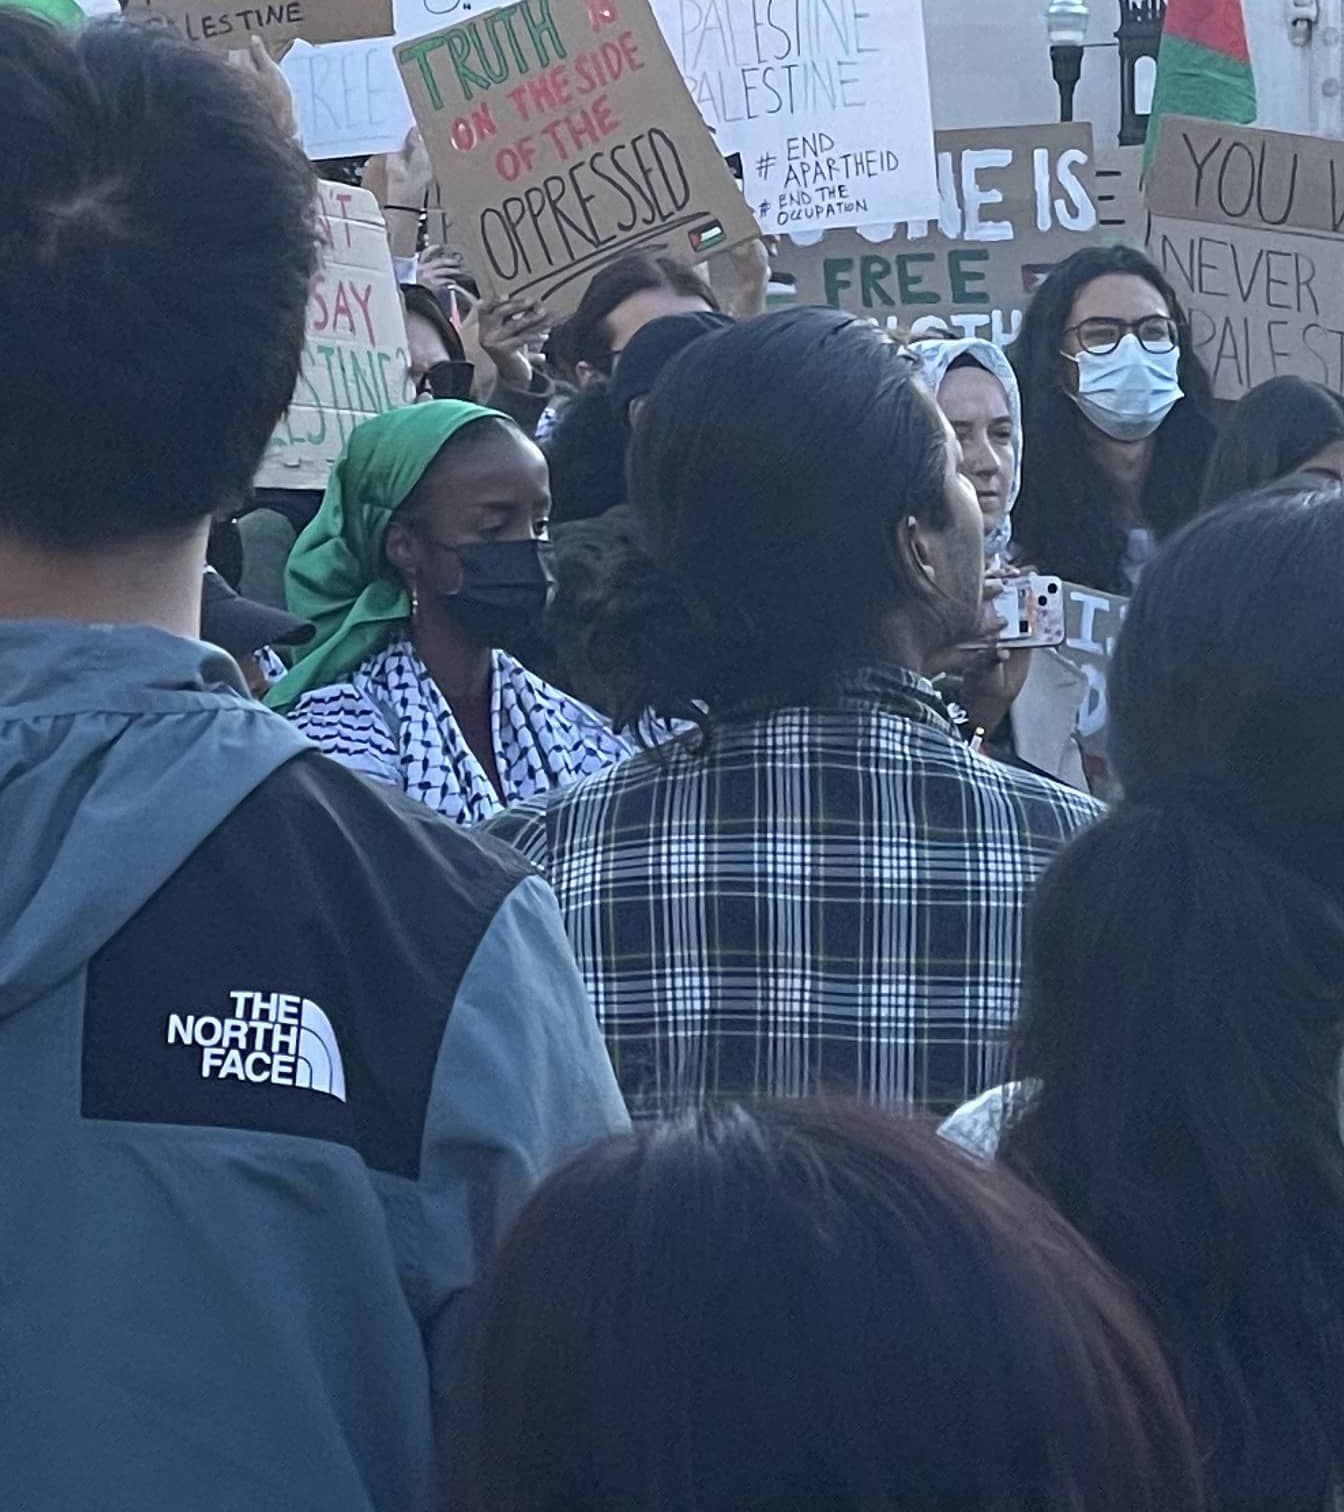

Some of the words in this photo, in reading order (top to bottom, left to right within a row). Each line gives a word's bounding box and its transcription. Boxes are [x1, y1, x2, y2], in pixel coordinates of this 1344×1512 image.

[146, 1, 304, 42] LESTINE
[450, 102, 498, 152] ON
[507, 63, 572, 122] THE
[575, 30, 645, 95] SIDE
[495, 135, 537, 183] OF
[540, 93, 623, 161] THE
[787, 132, 835, 162] END
[783, 148, 900, 190] APARTHEID
[1033, 147, 1097, 232] IS
[1182, 131, 1299, 226] YOU
[479, 127, 691, 281] OPPRESSED
[776, 199, 869, 226] OCCUPATION
[777, 189, 812, 213] END
[816, 183, 849, 204] THE
[822, 248, 991, 310] FREE
[1160, 233, 1320, 316] NEVER
[308, 274, 377, 349] SAY
[230, 991, 300, 1025] THE
[167, 1014, 298, 1055] NORTH
[202, 1048, 295, 1087] FACE
